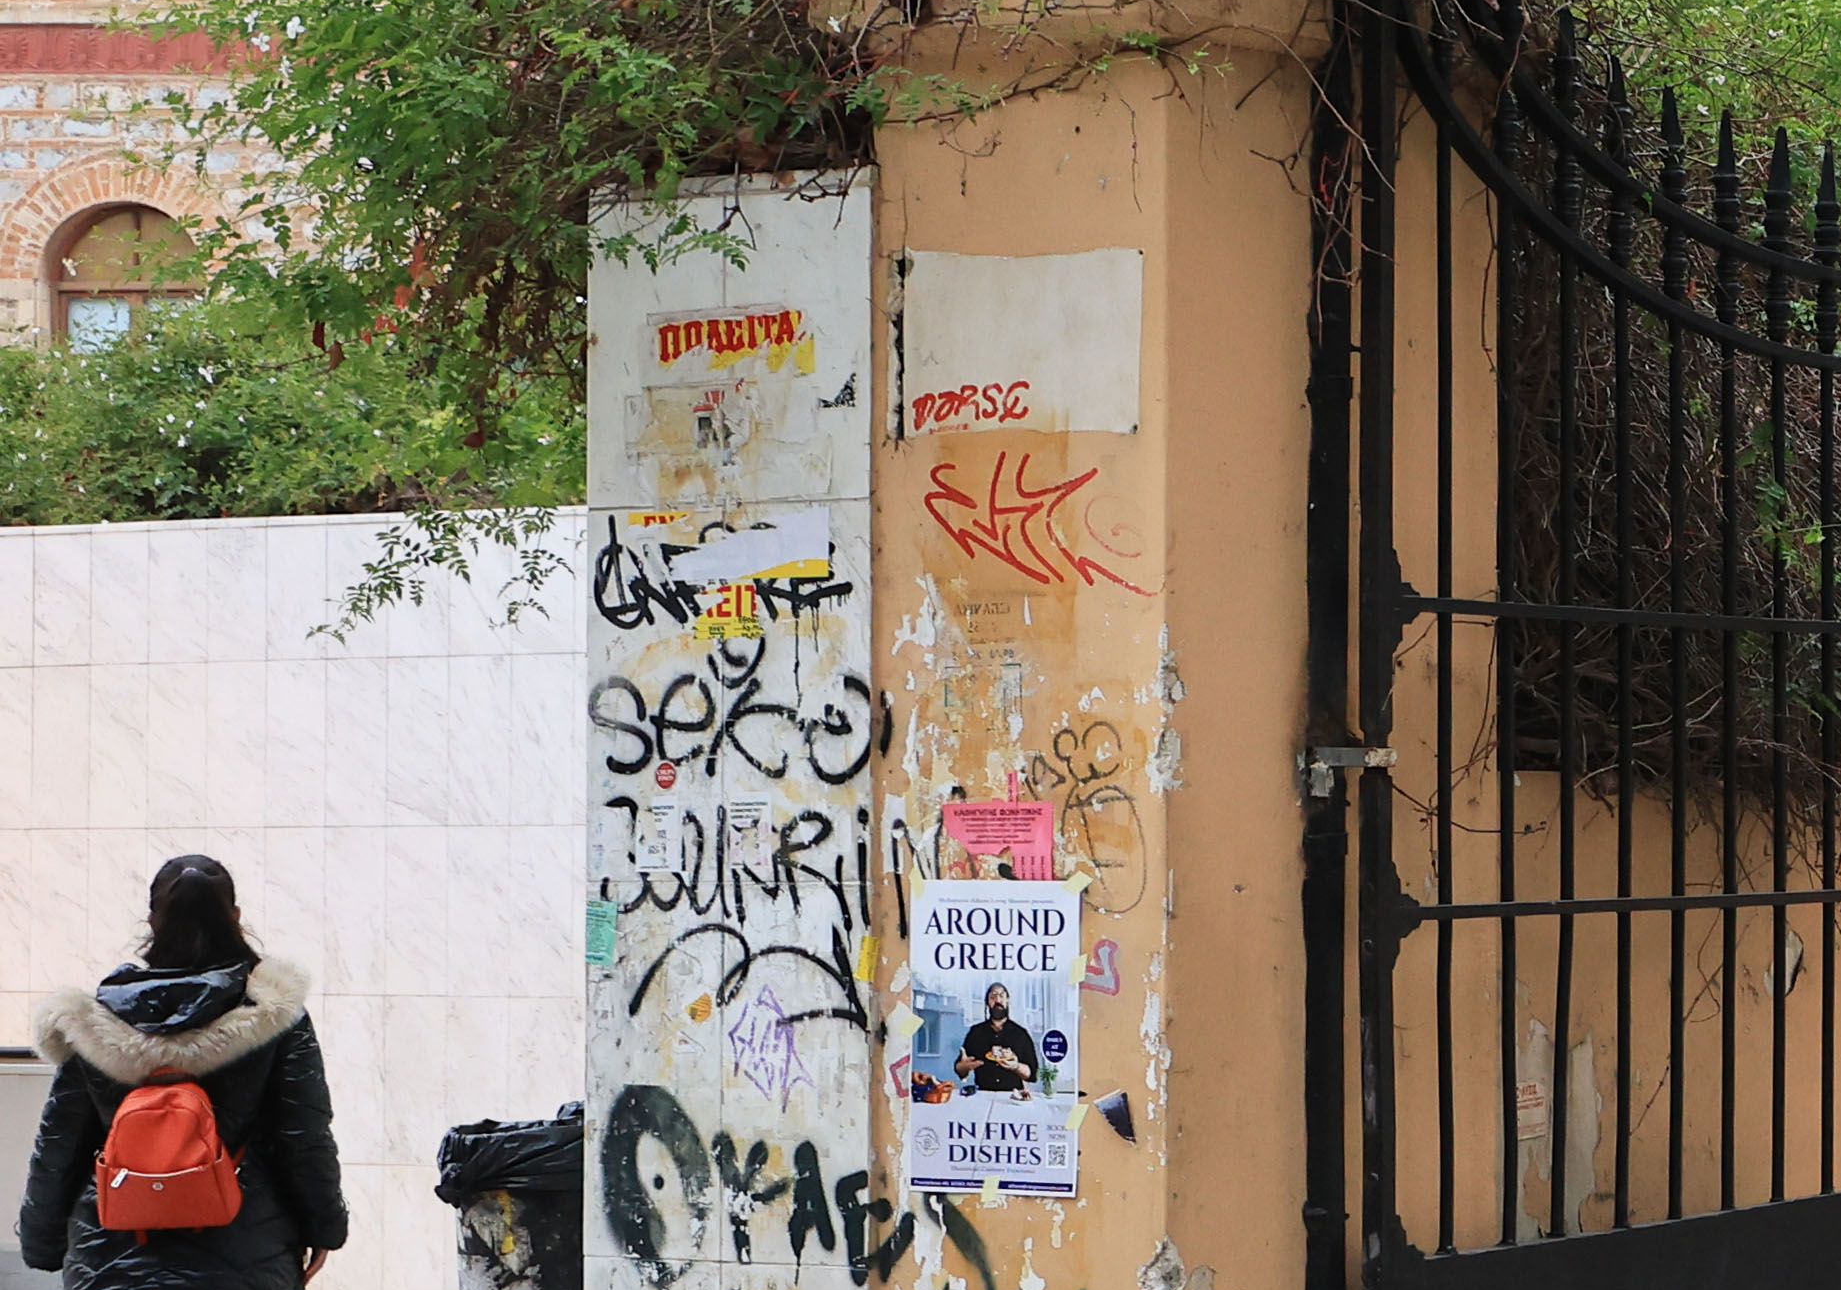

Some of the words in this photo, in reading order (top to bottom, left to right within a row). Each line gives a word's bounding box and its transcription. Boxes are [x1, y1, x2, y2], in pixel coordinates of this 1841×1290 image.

[924, 907, 1066, 937] AROUND
[934, 941, 1058, 972] GREECE
[948, 1120, 977, 1140] IN
[984, 1122, 1039, 1142] FIVE
[948, 1143, 1042, 1166] DISHES
